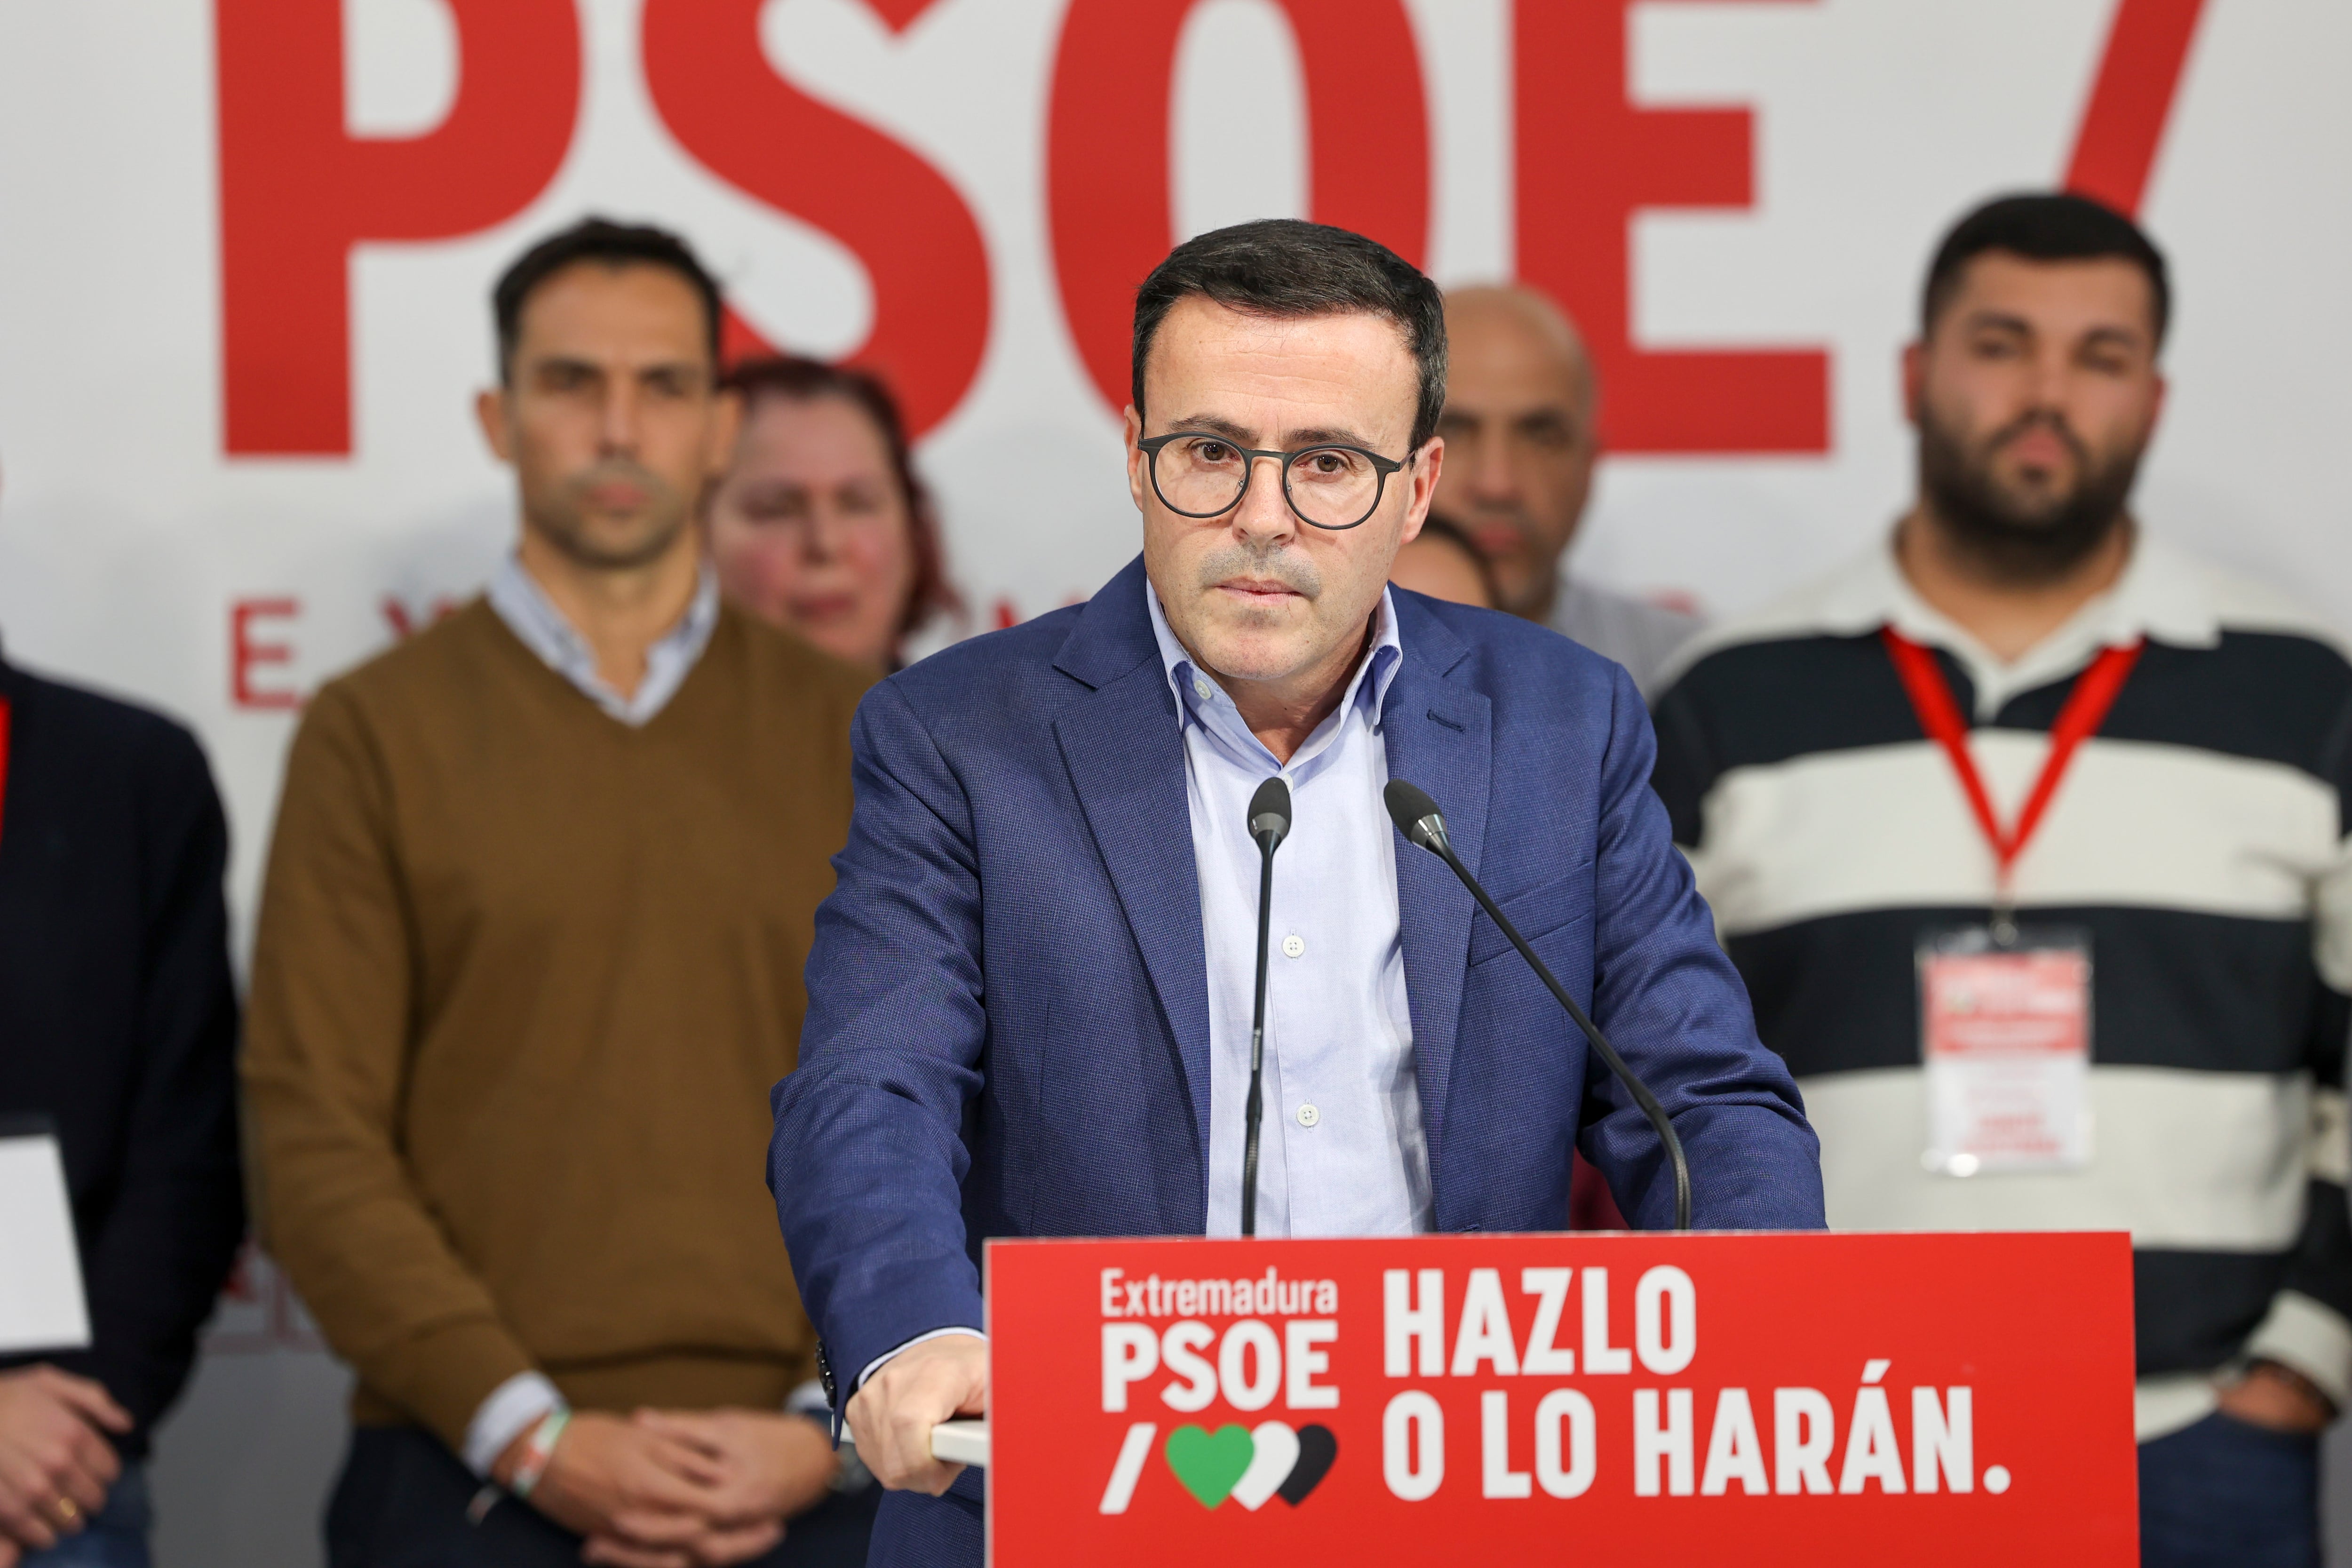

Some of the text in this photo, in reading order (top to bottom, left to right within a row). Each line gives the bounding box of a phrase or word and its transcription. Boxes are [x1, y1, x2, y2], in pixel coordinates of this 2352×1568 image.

[214, 0, 1832, 460] PSOE
[1100, 1265, 1339, 1318] Extremadura
[1383, 1264, 1697, 1377] HAZLO
[1100, 1319, 1340, 1413] PSOE
[1382, 1358, 2011, 1501] O LO HARÁN.
